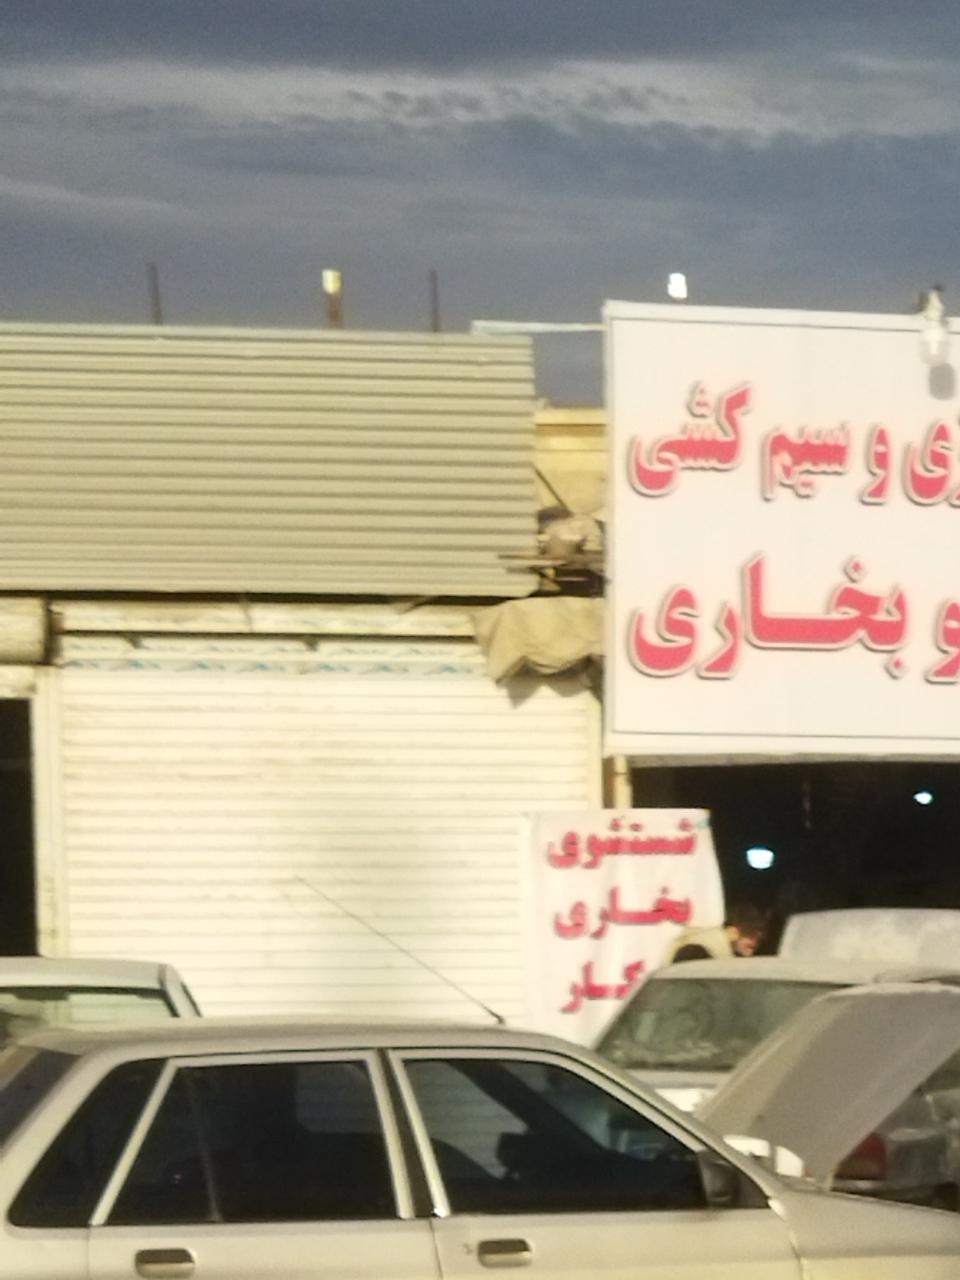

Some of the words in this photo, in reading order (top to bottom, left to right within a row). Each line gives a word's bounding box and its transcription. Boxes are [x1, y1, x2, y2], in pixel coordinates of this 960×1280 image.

[631, 383, 753, 495] کشی
[763, 424, 854, 497] سیم
[864, 426, 896, 502] و
[631, 555, 911, 676] بخاری
